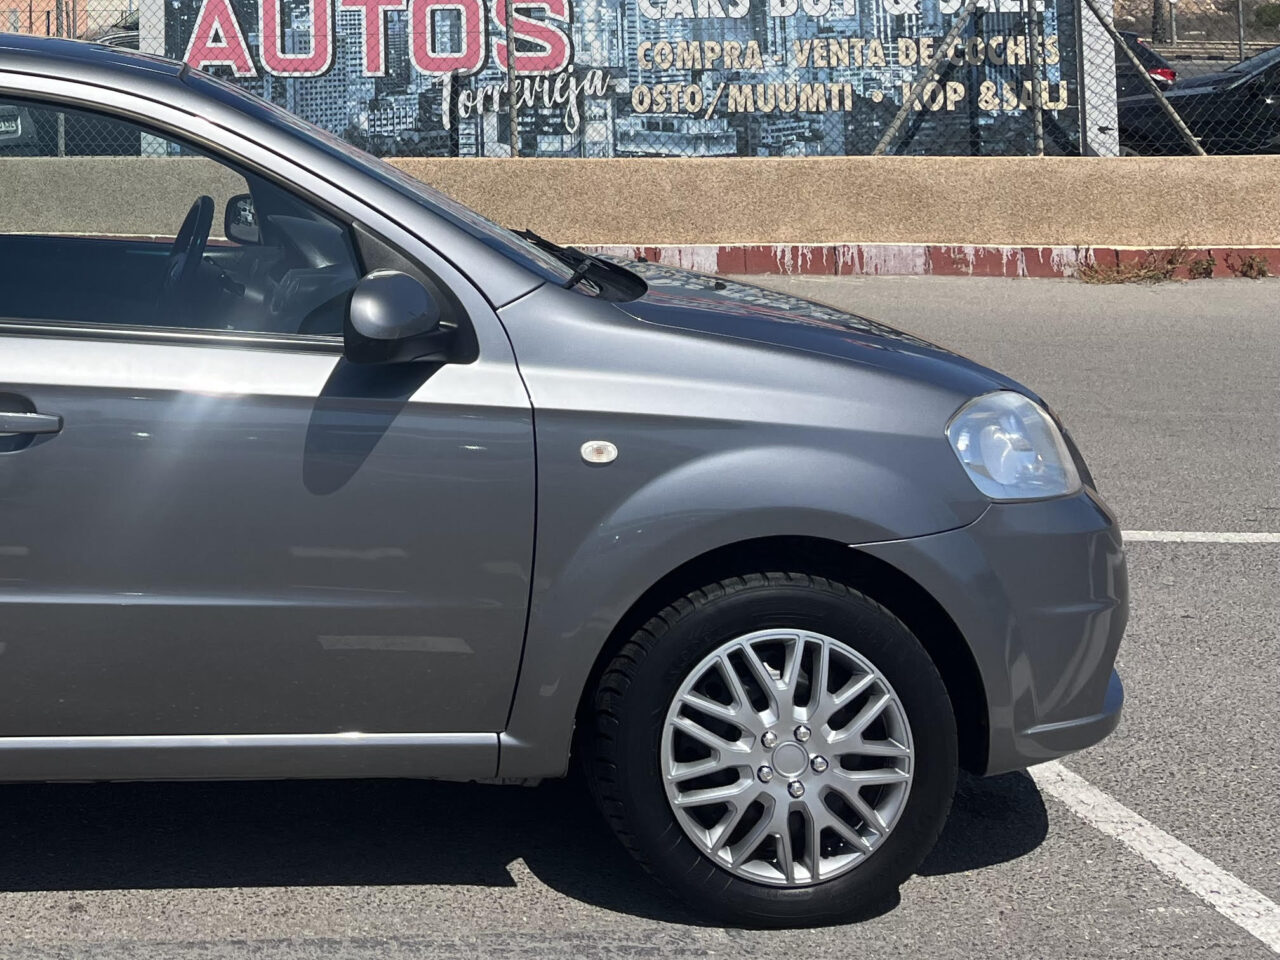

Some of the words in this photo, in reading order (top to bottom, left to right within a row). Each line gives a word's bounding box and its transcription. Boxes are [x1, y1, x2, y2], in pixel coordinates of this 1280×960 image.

[637, 40, 764, 70] COMPRA
[793, 37, 886, 68] VENTA
[898, 36, 936, 66] DE
[434, 64, 611, 132] Torrevieja
